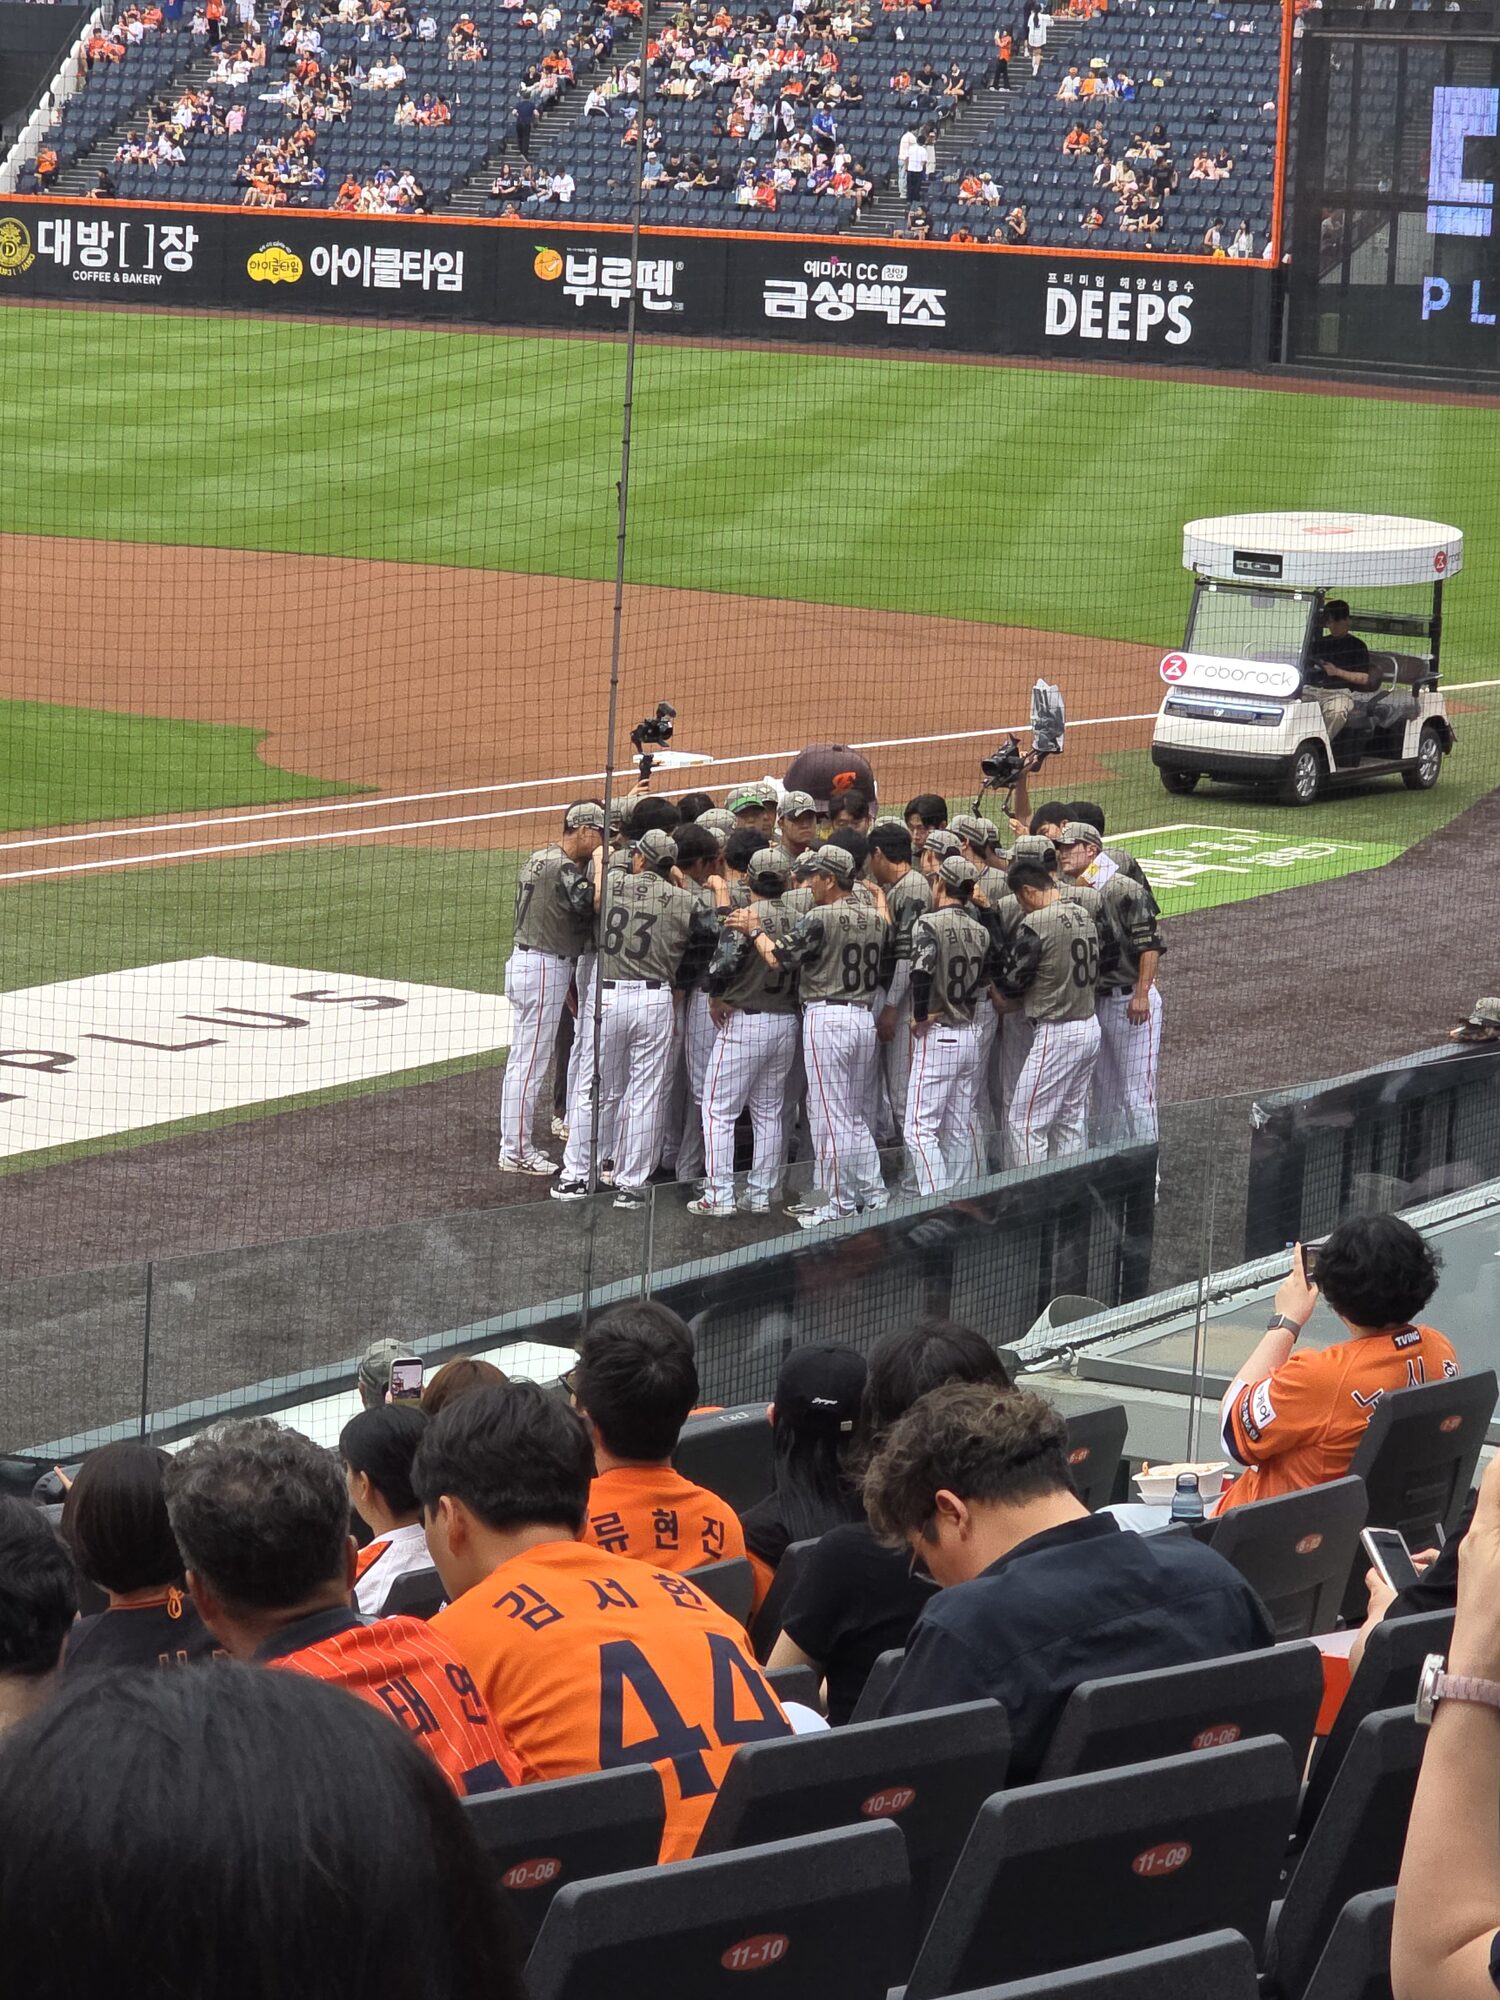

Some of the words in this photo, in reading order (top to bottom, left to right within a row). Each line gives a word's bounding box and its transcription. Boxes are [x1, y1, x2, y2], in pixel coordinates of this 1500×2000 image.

[73, 270, 111, 283] COFFEE
[113, 272, 120, 283] &
[122, 273, 163, 286] BAKERY
[310, 244, 463, 291] 아이클타임
[803, 260, 852, 279] 예미지
[856, 263, 879, 281] CC
[1047, 273, 1105, 288] 프리미엄
[1119, 277, 1195, 293] 해양심층수
[763, 279, 947, 327] 금성백조
[1045, 287, 1194, 345] DEEPS
[1193, 663, 1292, 686] roborock
[604, 906, 658, 960] 83
[842, 942, 880, 992] 88
[590, 1508, 725, 1559] 류현진
[492, 1573, 707, 1631] 김서현
[376, 1663, 488, 1735] 태연
[599, 1631, 796, 1799] 44
[1197, 1727, 1236, 1748] 10-06
[867, 1789, 912, 1813] 10-07
[508, 1860, 555, 1885] 10-08
[1137, 1846, 1188, 1872] 11-09
[731, 1939, 784, 1967] 11-10
